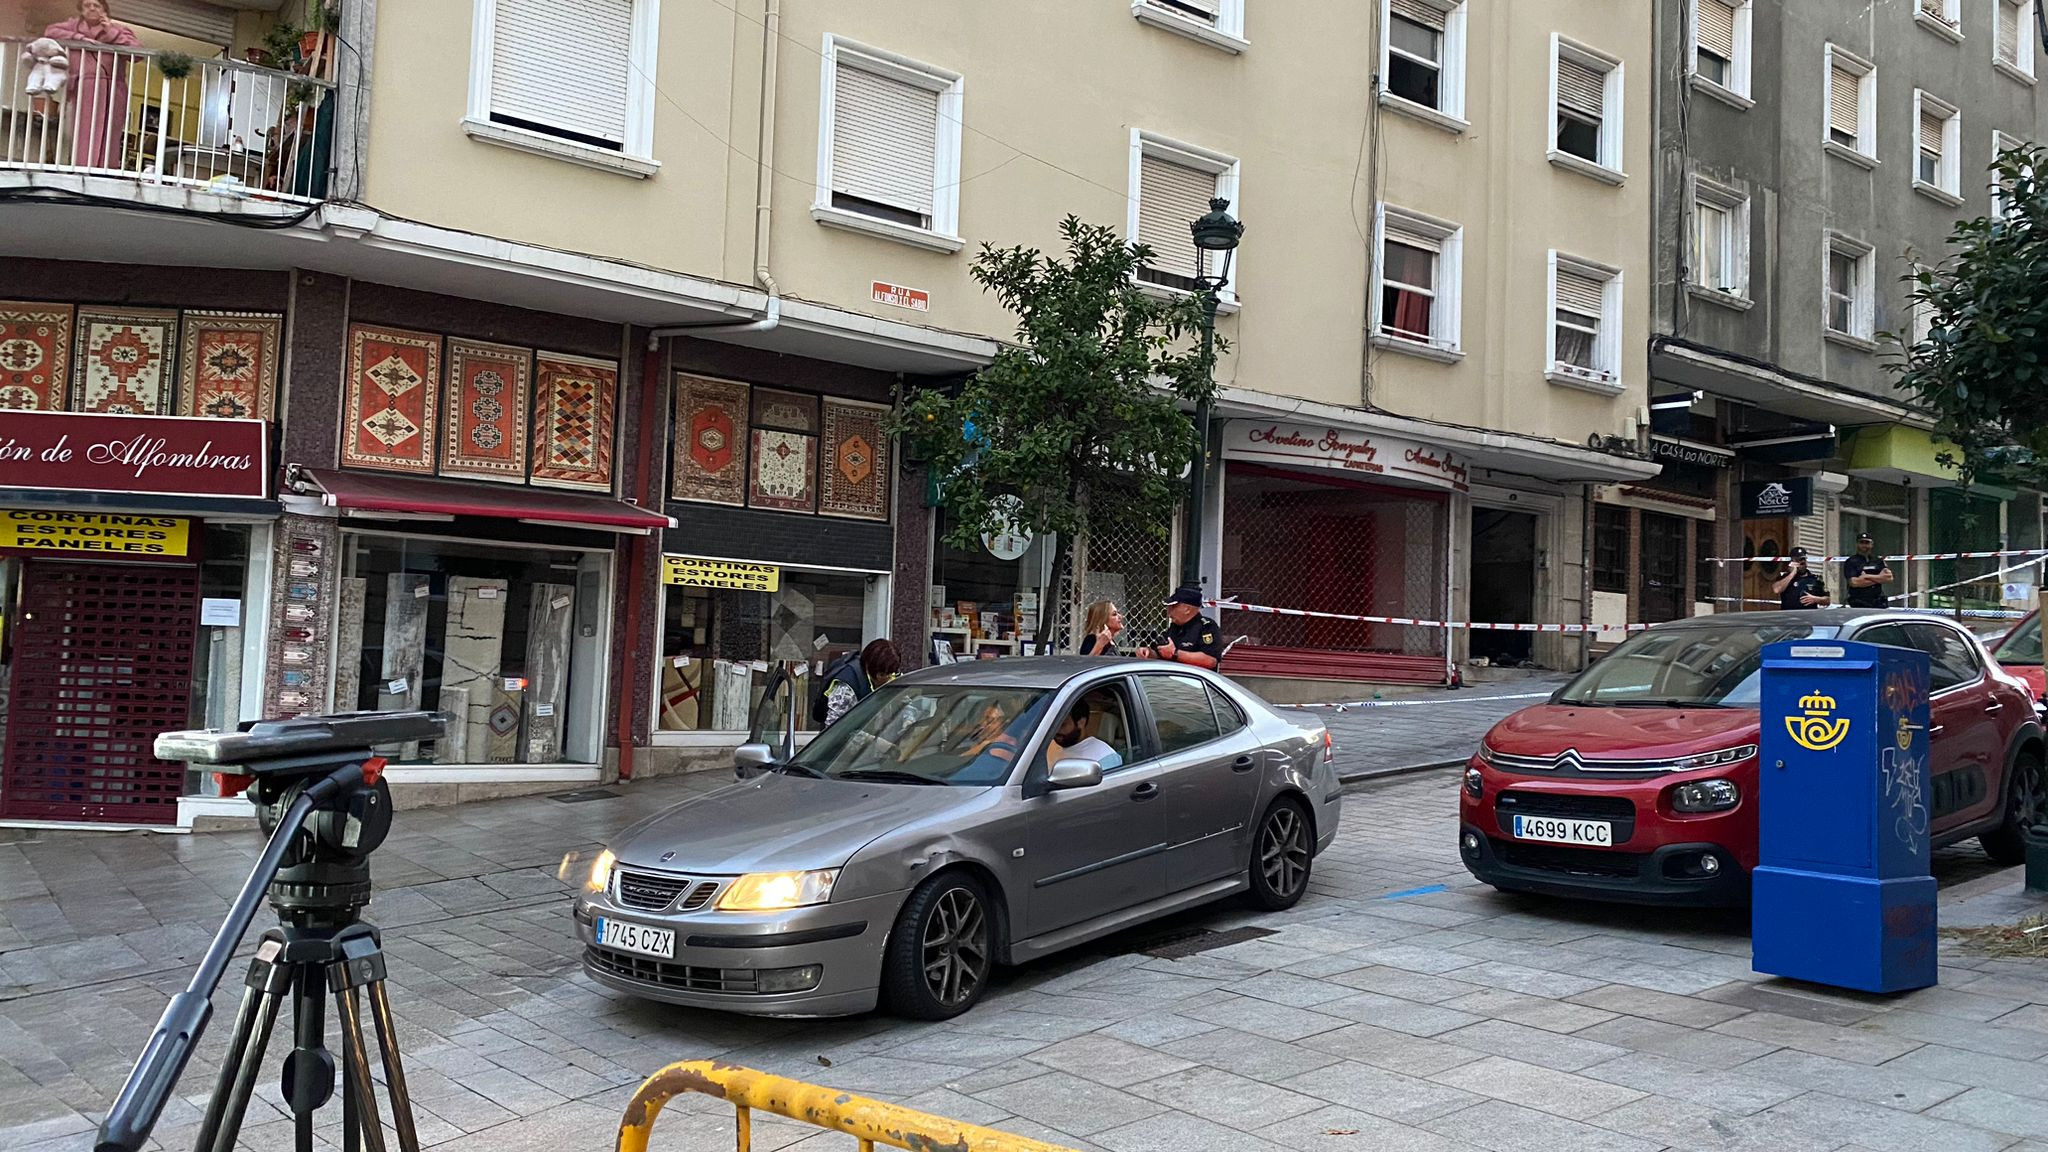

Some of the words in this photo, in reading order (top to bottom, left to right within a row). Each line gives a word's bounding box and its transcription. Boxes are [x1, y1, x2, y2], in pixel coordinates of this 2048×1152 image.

[890, 286, 911, 297] RUA
[0, 437, 33, 460] ón
[41, 434, 73, 462] de
[86, 433, 252, 478] Alfombras
[1660, 443, 1684, 460] CASA
[1697, 450, 1729, 468] NORTE
[8, 511, 177, 528] CORTINAS
[16, 524, 167, 540] ESTORES
[16, 537, 165, 554] PANELES
[666, 558, 775, 573] CORTINAS
[672, 567, 769, 582] ESTORES
[673, 577, 768, 591] PANELES
[1525, 819, 1567, 839] 4699
[1572, 822, 1607, 842] KCC
[606, 922, 637, 948] 1745
[641, 929, 671, 955] CZX
